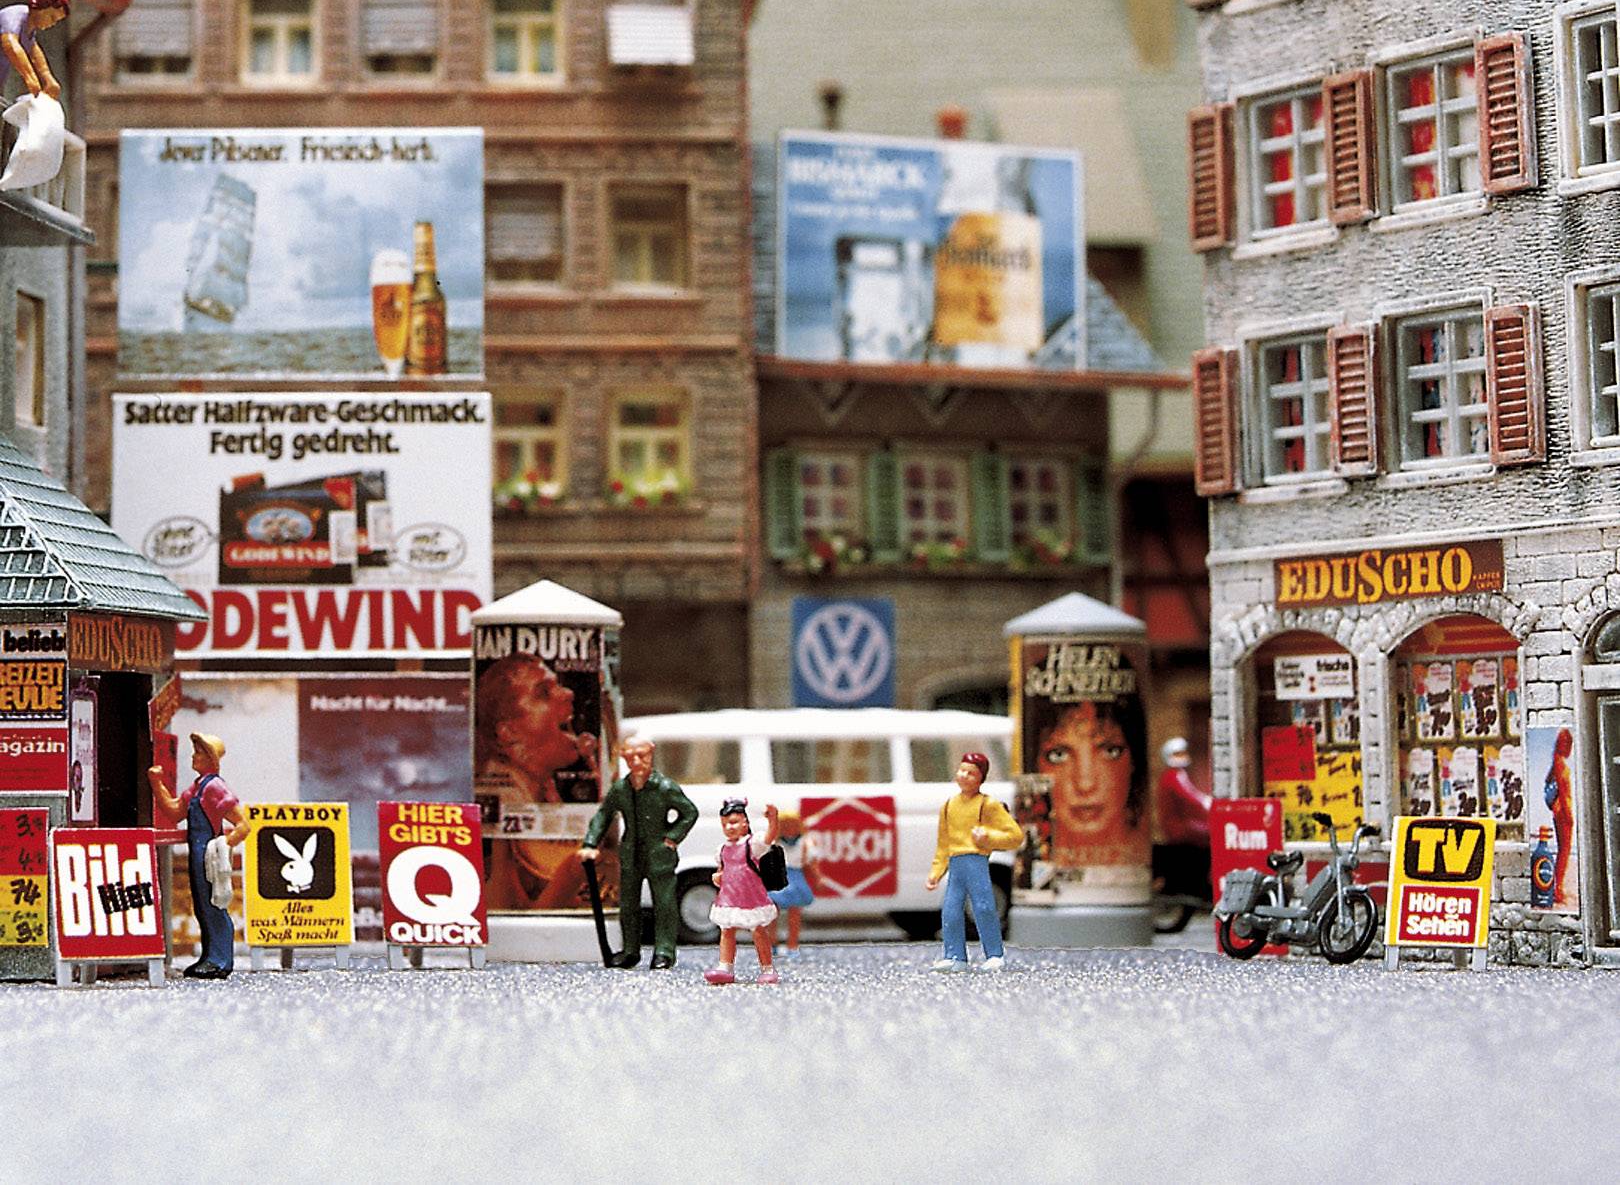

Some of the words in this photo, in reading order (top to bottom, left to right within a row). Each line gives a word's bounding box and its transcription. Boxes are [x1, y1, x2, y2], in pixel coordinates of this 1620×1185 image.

[124, 400, 197, 425] Satter
[210, 426, 283, 460] Fertig
[292, 430, 401, 460] gedreht.
[1278, 547, 1473, 605] EDUSCHO
[3, 629, 67, 653] belieb
[70, 616, 162, 671] EDUSCHO
[476, 625, 512, 660] IAN
[517, 626, 593, 661] DURY
[250, 808, 342, 821] PLAYBOY
[398, 804, 464, 824] HIER
[388, 825, 473, 846] GIBT'S
[1224, 822, 1268, 850] Rum
[1411, 827, 1481, 874] TV
[56, 843, 157, 937] Bild
[387, 845, 482, 925] Q
[97, 881, 154, 915] Hier
[281, 901, 314, 914] Alles
[1408, 891, 1472, 914] Hören
[250, 917, 277, 927] was
[281, 914, 345, 927] Männern
[390, 921, 483, 944] QUICK
[1406, 914, 1470, 937] Sehen
[257, 927, 292, 942] Spaß
[296, 928, 339, 941] macht
